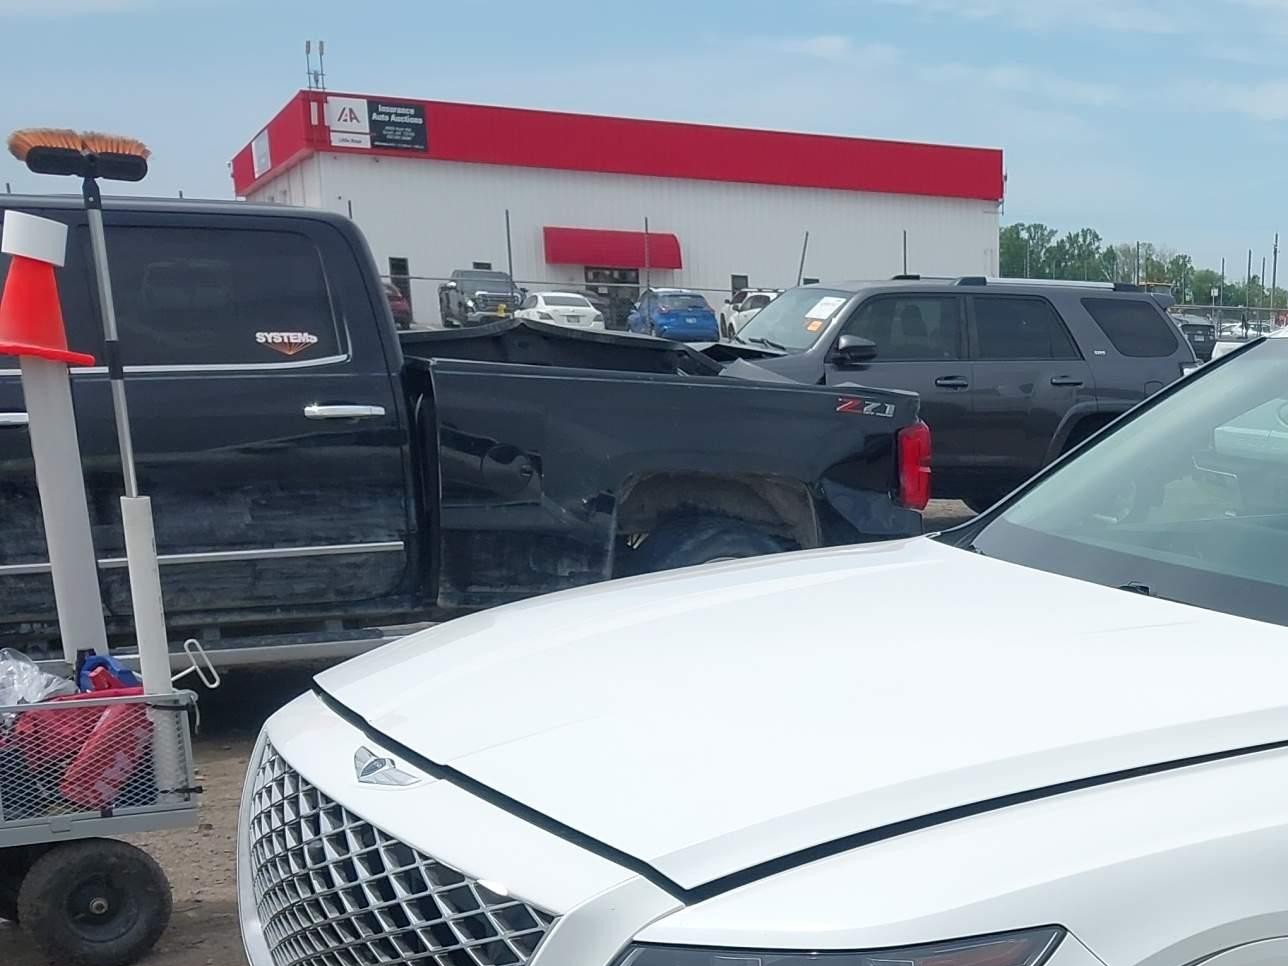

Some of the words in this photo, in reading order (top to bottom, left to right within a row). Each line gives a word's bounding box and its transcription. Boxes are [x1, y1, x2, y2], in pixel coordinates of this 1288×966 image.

[371, 112, 389, 122] Auto
[390, 113, 423, 125] Auctions
[835, 397, 896, 417] Z71
